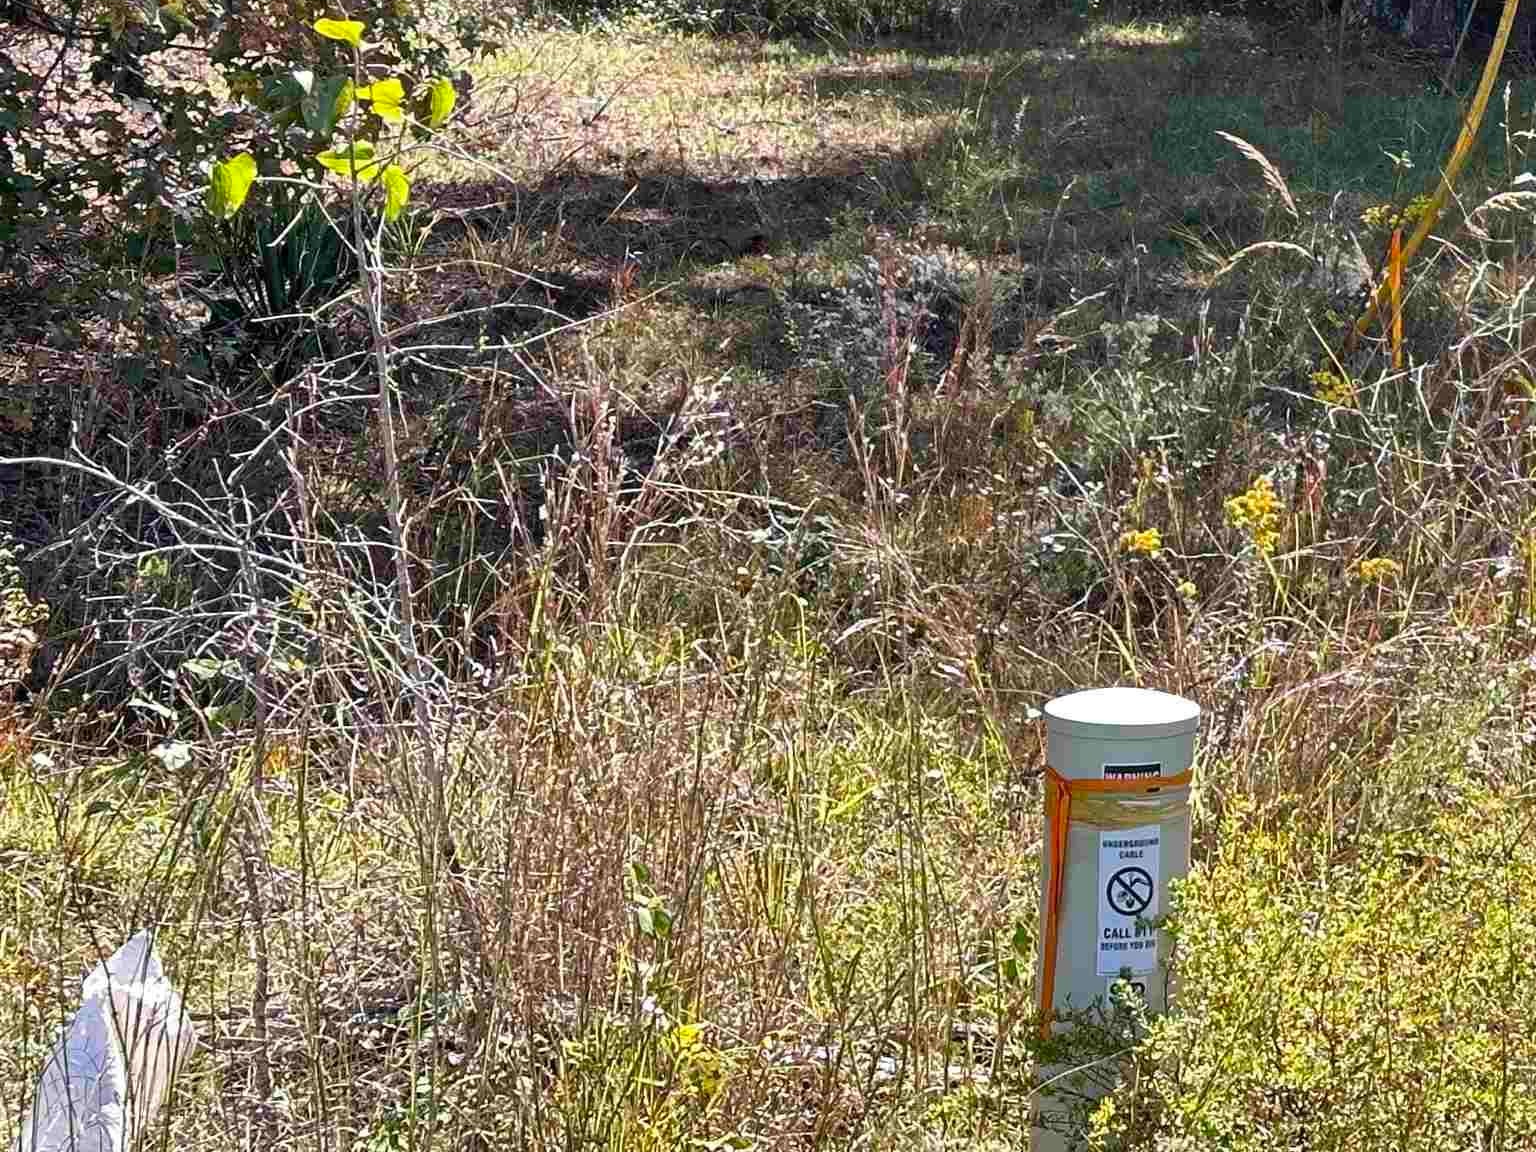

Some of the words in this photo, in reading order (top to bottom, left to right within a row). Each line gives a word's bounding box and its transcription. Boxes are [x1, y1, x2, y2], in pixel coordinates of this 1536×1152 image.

[1102, 837, 1159, 848] UNDERGROUND
[1119, 850, 1143, 859] CABLE
[1103, 927, 1132, 939] CALL
[1101, 942, 1128, 950] BEFORE
[1130, 941, 1143, 950] YOU
